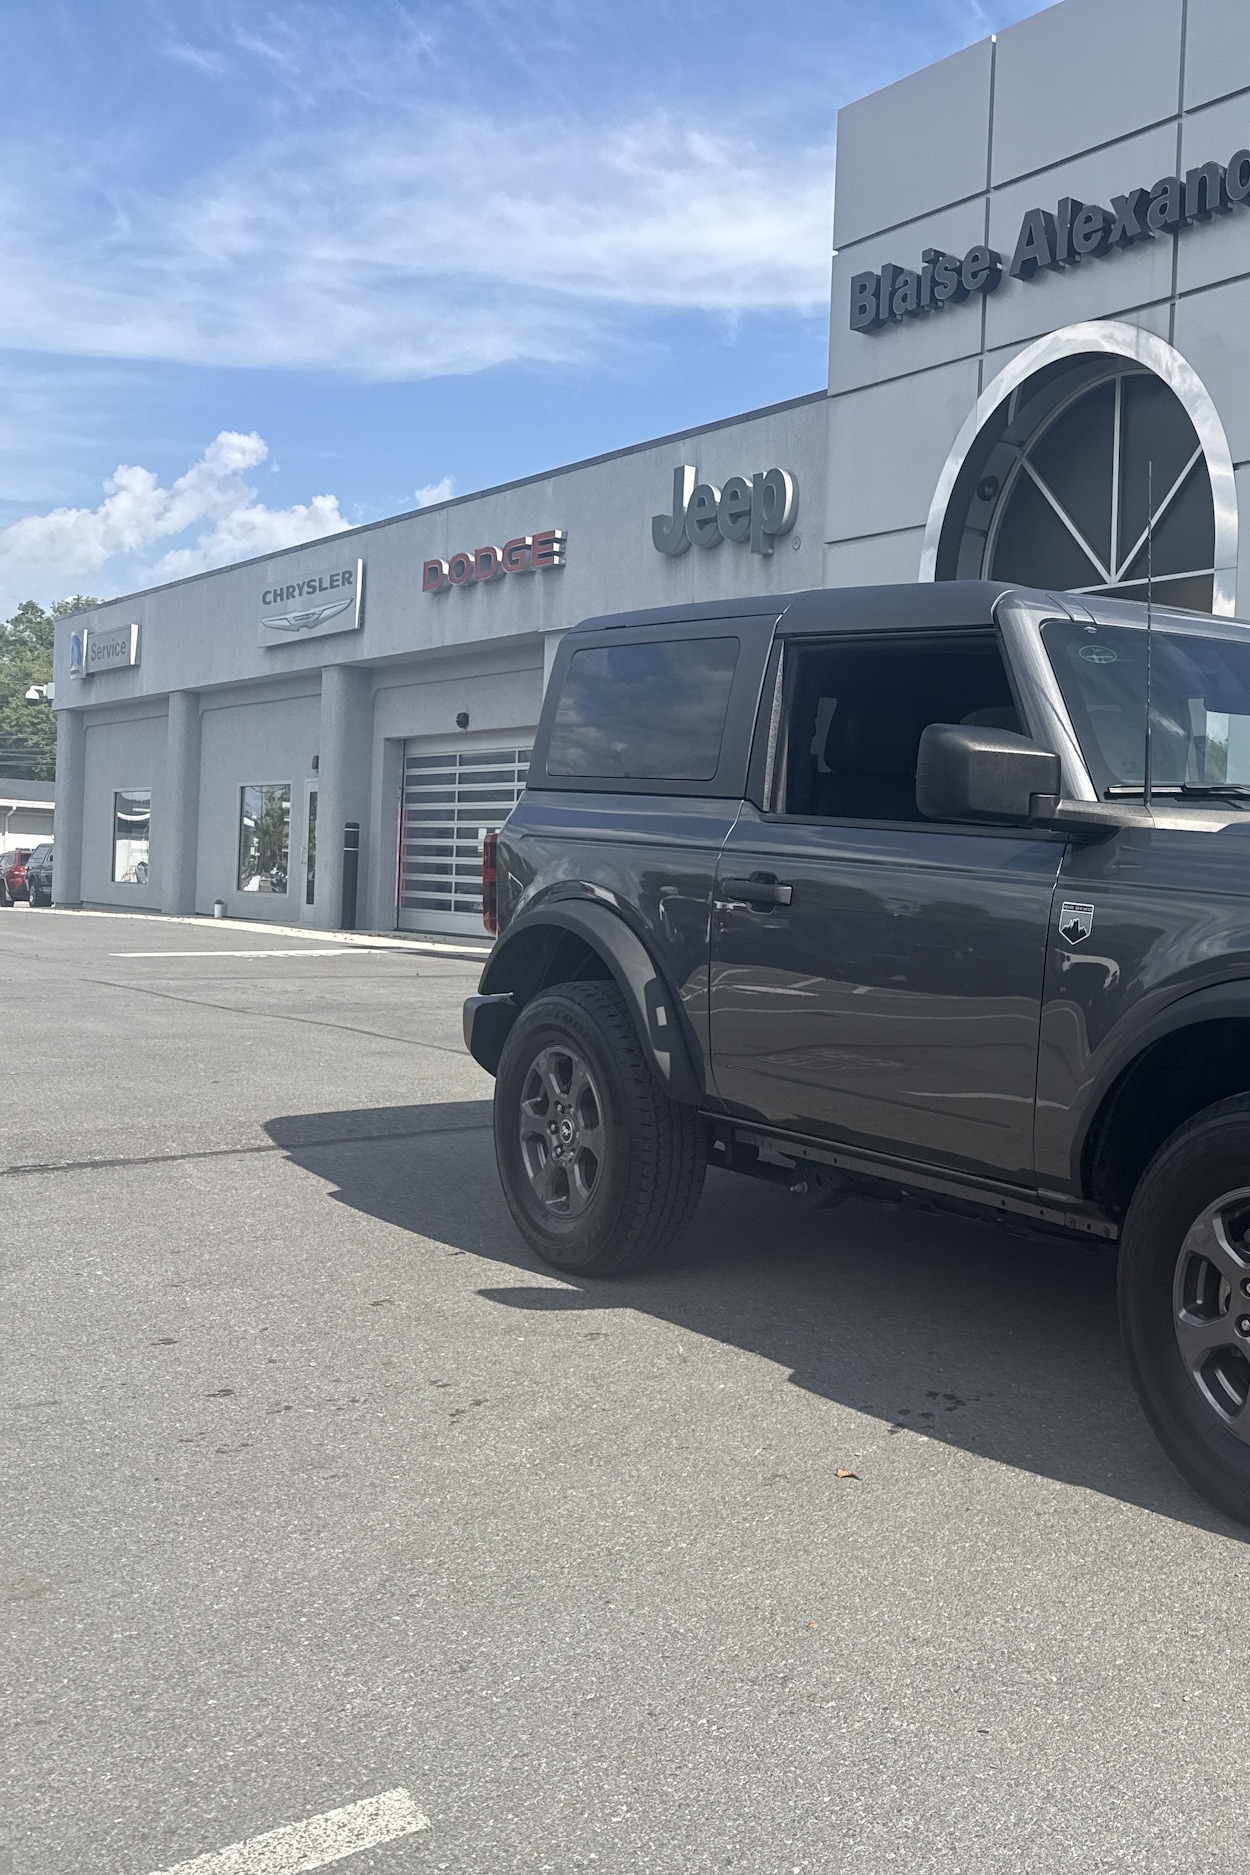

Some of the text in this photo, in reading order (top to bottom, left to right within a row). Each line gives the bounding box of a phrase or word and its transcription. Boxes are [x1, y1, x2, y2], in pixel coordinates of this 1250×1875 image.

[850, 246, 1003, 333] Blaise
[652, 464, 796, 555] Jeep
[262, 570, 353, 605] CHRYSLER
[422, 529, 567, 592] DODGE
[91, 638, 126, 661] Service
